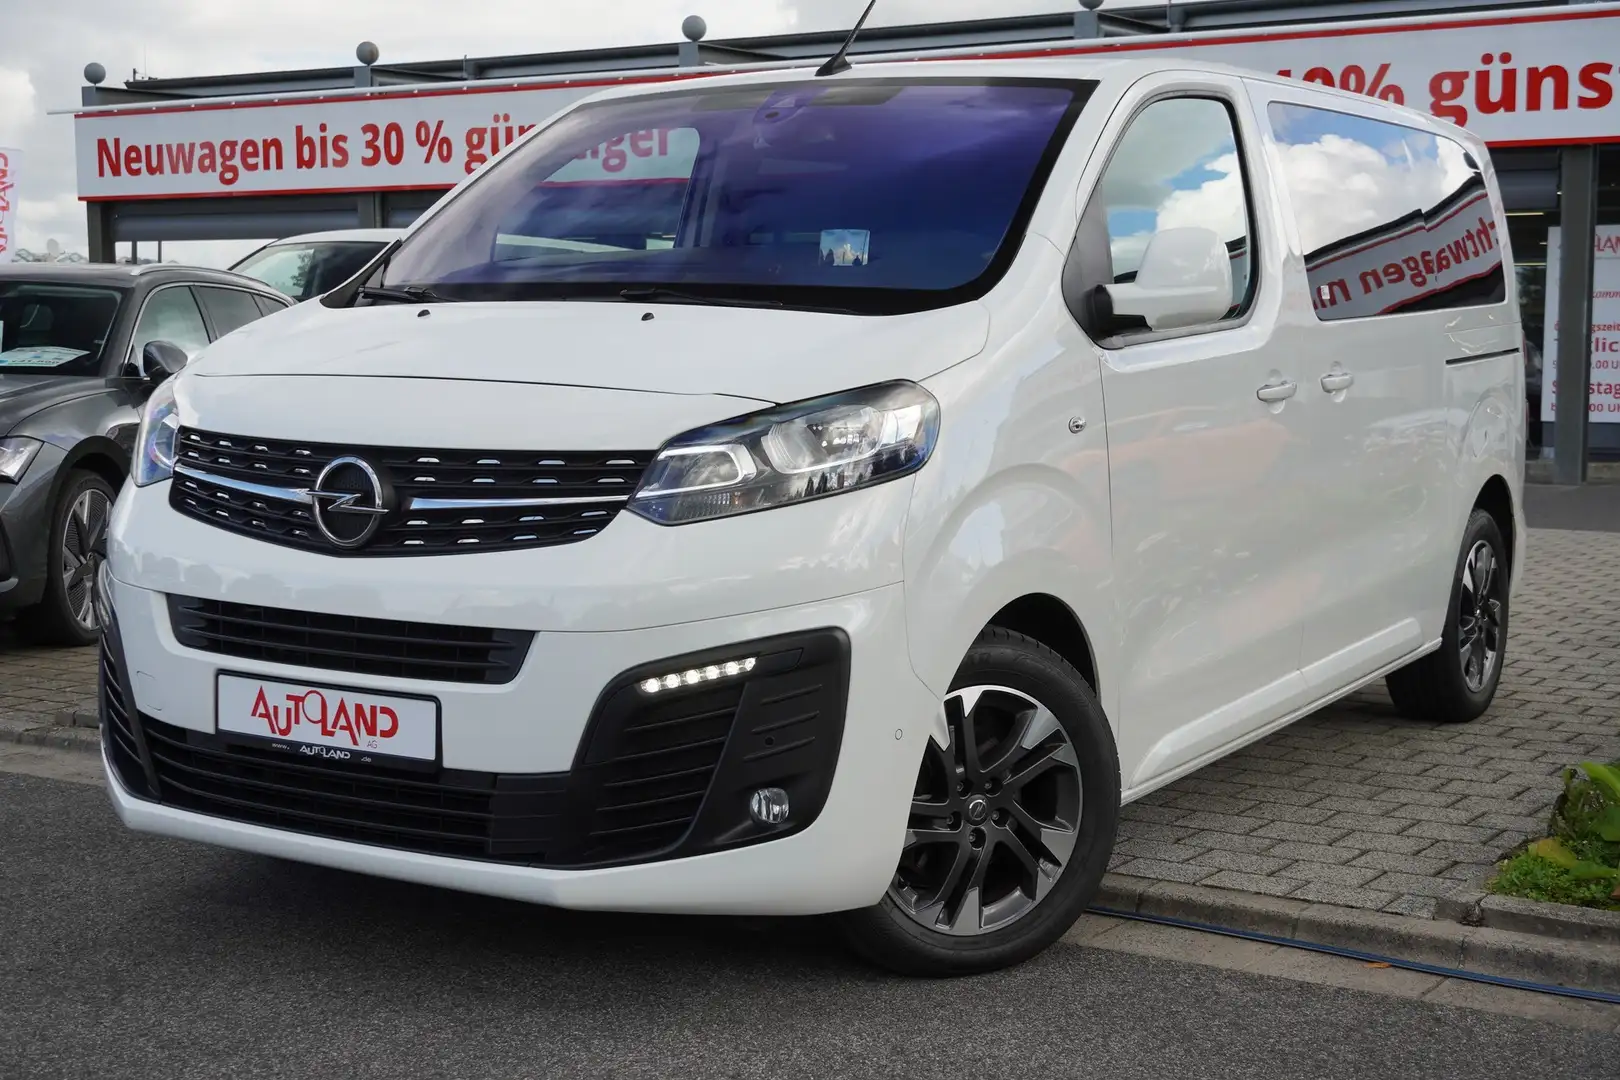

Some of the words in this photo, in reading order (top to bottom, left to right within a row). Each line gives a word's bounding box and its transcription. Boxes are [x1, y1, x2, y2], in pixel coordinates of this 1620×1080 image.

[1429, 52, 1620, 128] güns
[97, 136, 283, 185] Neuwagen
[295, 123, 349, 169] bis
[361, 121, 404, 167] 30
[415, 120, 453, 164] %
[366, 740, 378, 749] AG
